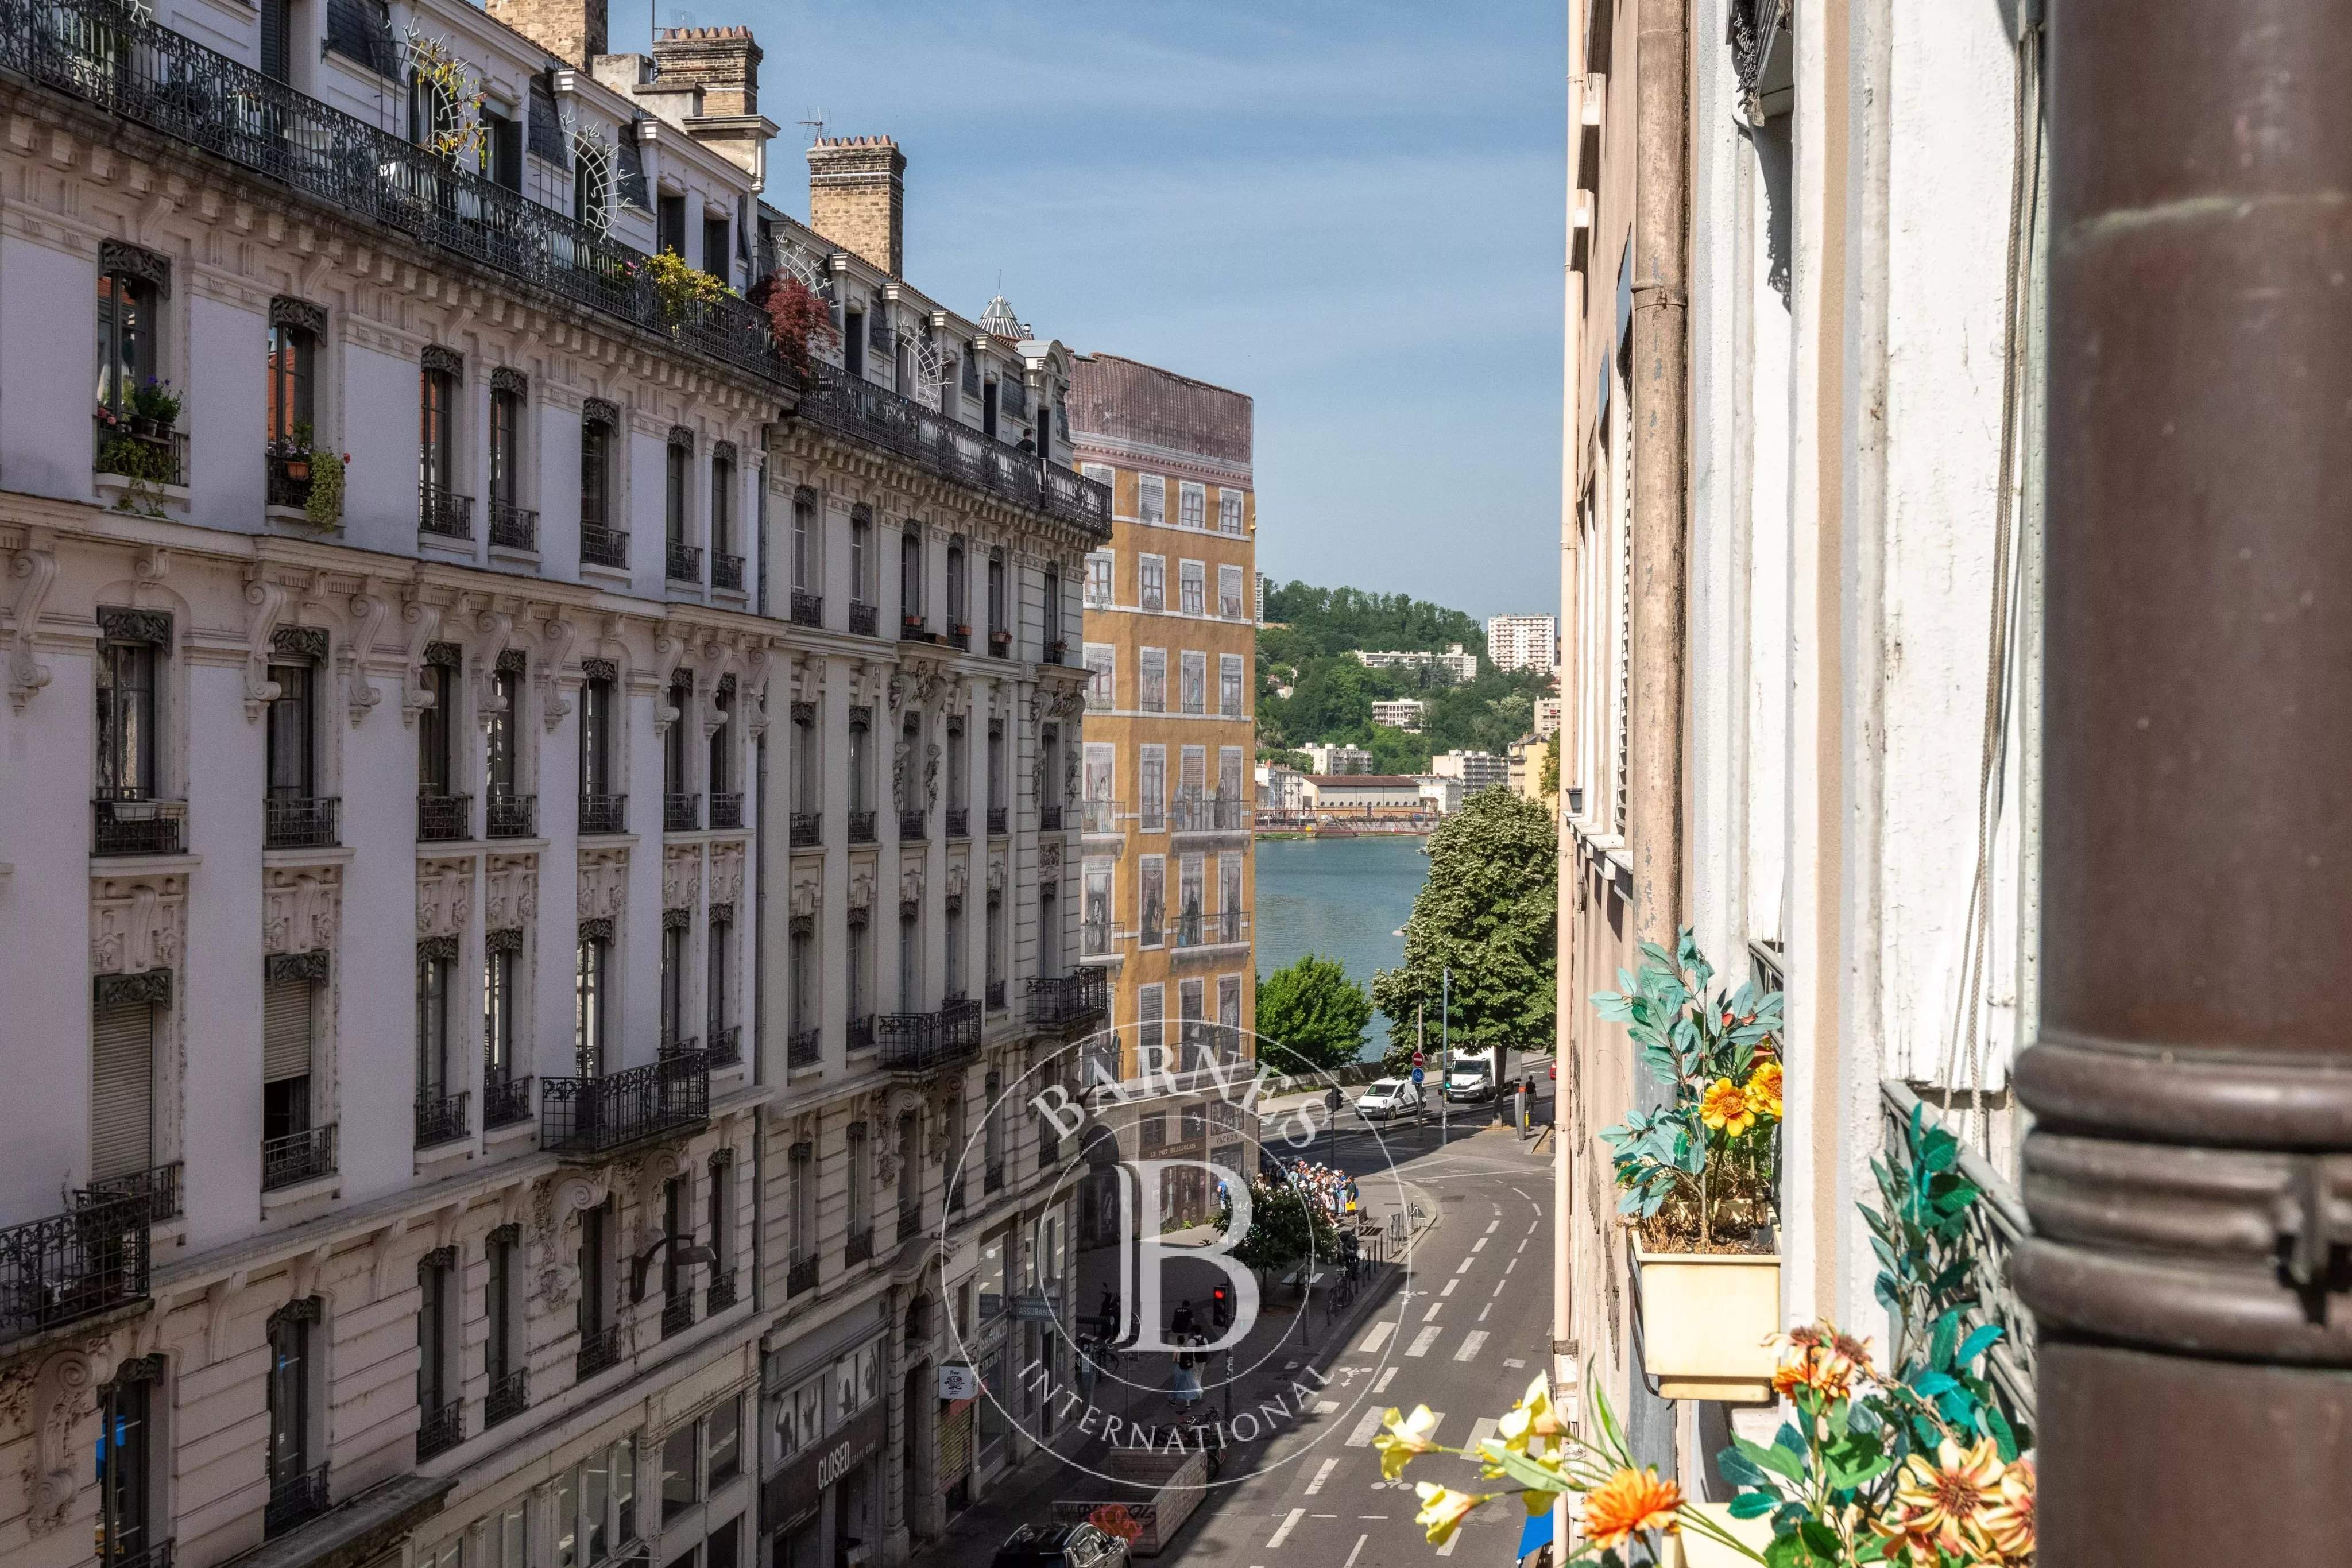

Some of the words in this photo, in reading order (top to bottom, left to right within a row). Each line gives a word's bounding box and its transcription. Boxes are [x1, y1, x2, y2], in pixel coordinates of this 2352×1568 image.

[1216, 1134, 1238, 1144] VACHON
[1170, 1143, 1196, 1153] BEAUJOLAIS
[1019, 1306, 1059, 1317] ASSURANCES
[818, 1440, 850, 1490] CLOSED
